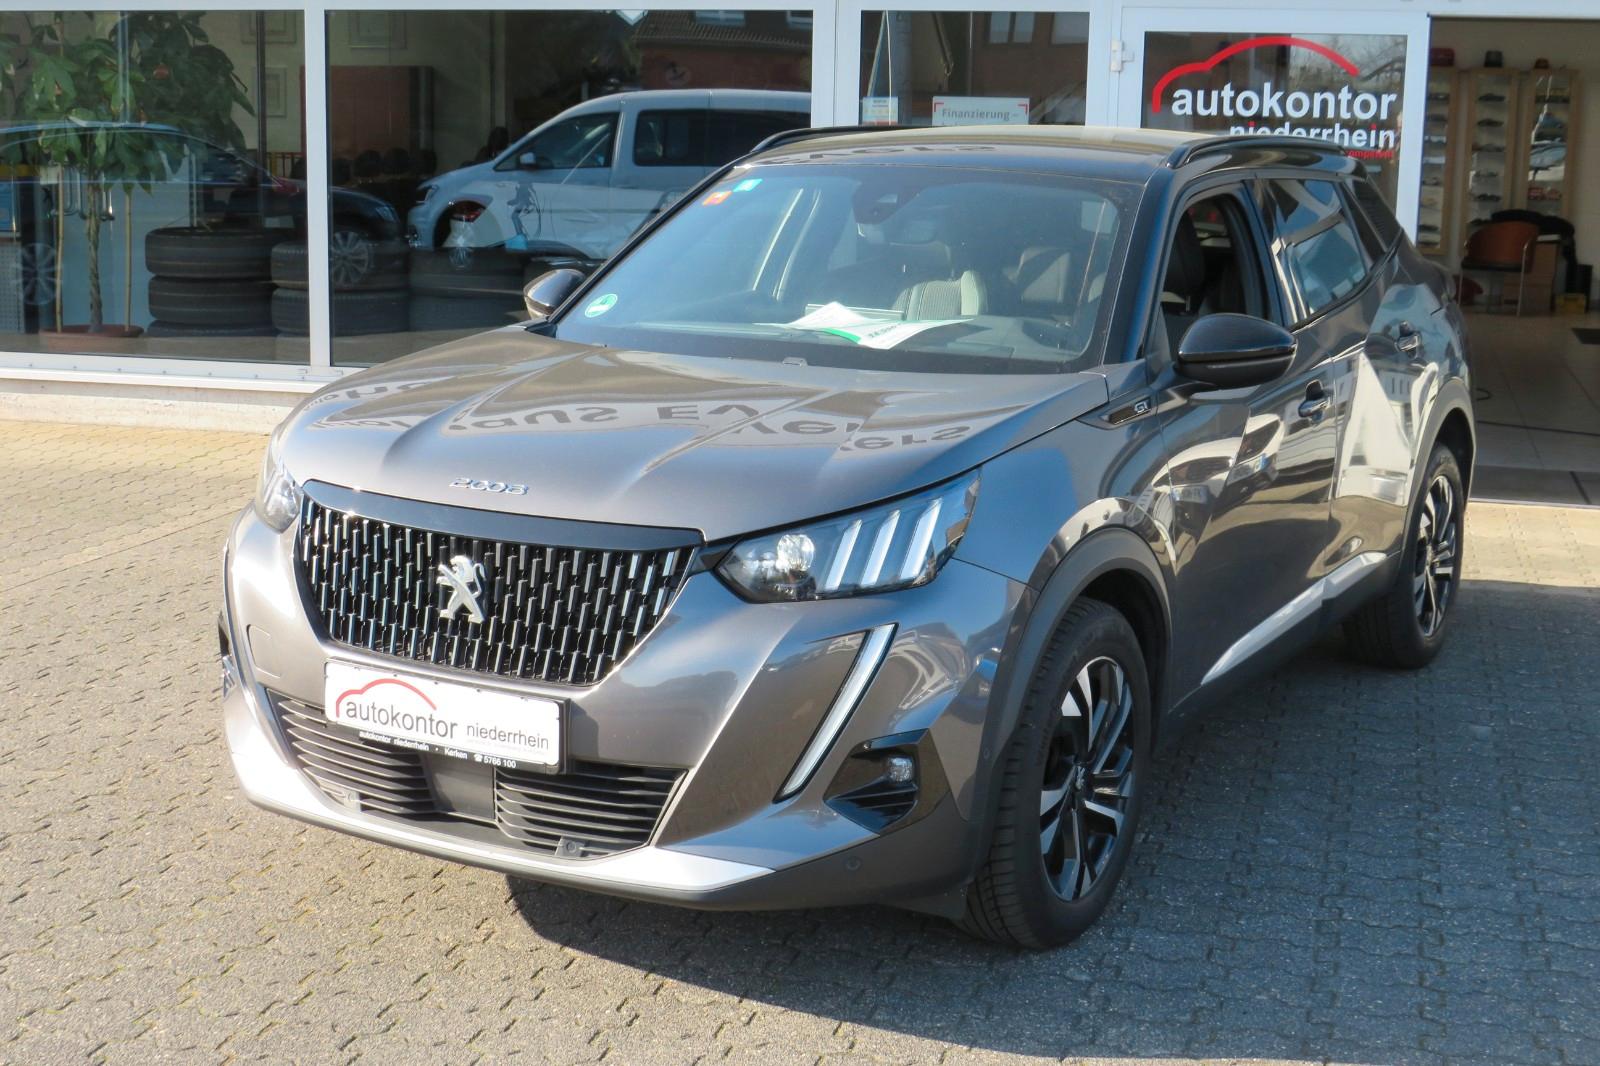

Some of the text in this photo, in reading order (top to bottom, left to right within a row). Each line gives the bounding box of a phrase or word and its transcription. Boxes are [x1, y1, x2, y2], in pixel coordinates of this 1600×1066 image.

[942, 108, 1010, 122] Finanzierung
[1171, 82, 1396, 119] autokontor
[449, 475, 527, 496] 2008
[346, 700, 459, 739] autokontor
[466, 723, 549, 751] niederrhein
